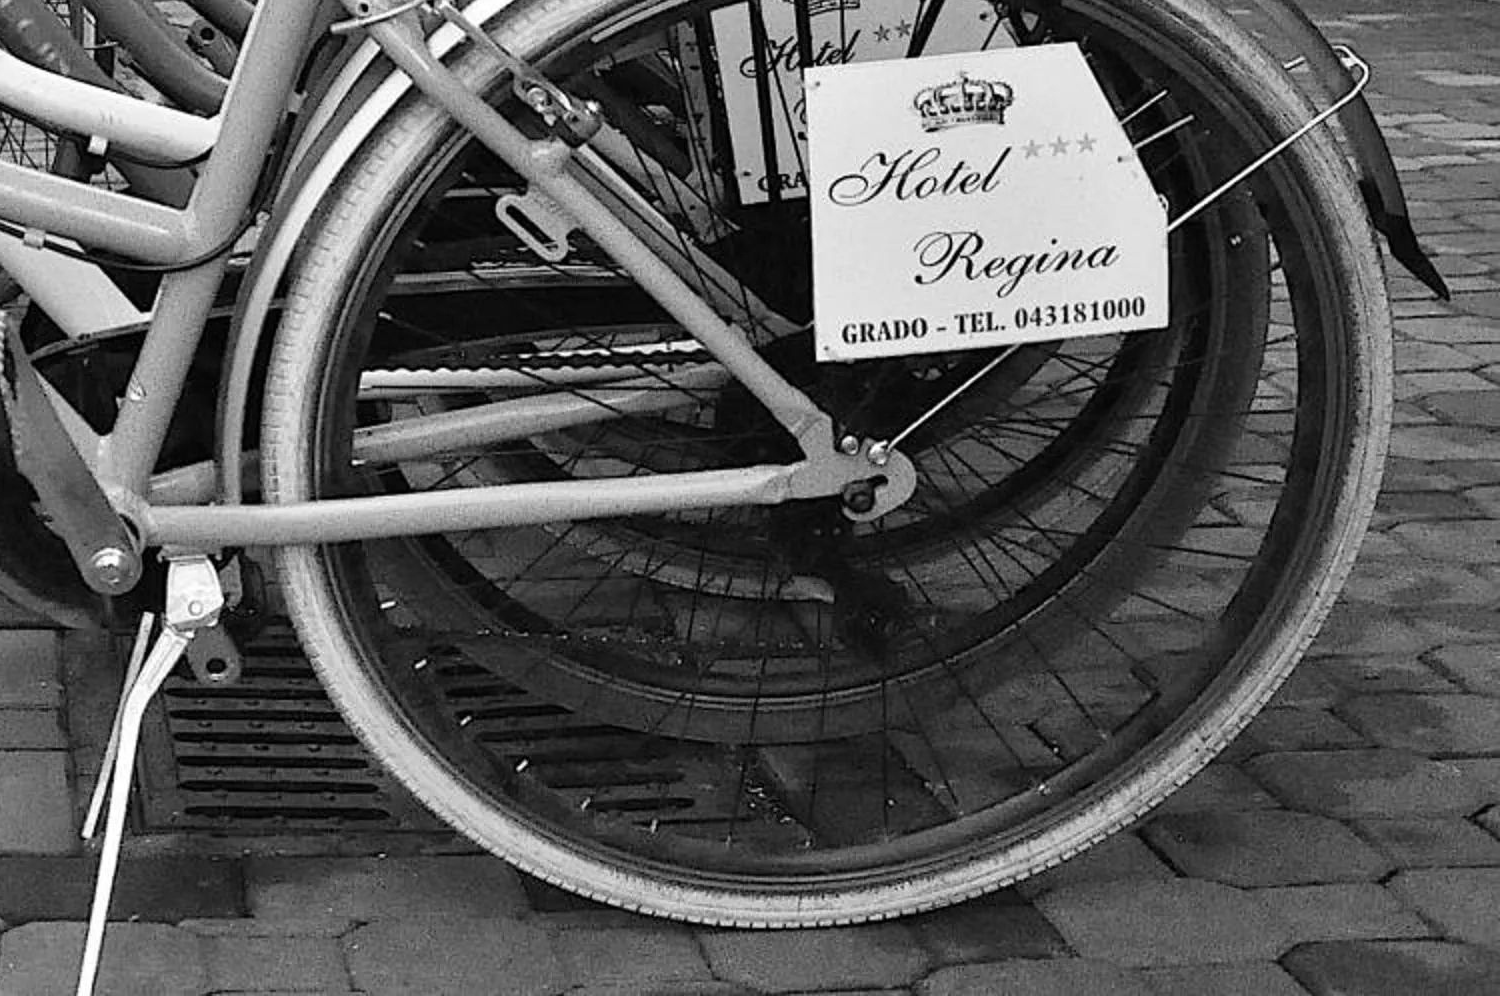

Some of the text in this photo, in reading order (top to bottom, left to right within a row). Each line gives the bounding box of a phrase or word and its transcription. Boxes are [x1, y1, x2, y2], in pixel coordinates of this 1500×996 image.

[739, 28, 861, 78] Htel
[828, 145, 1012, 207] Hotel
[913, 230, 1121, 299] Regina
[841, 316, 929, 345] GRADO
[953, 310, 1006, 335] TEL.
[1014, 295, 1146, 329] 043181000
